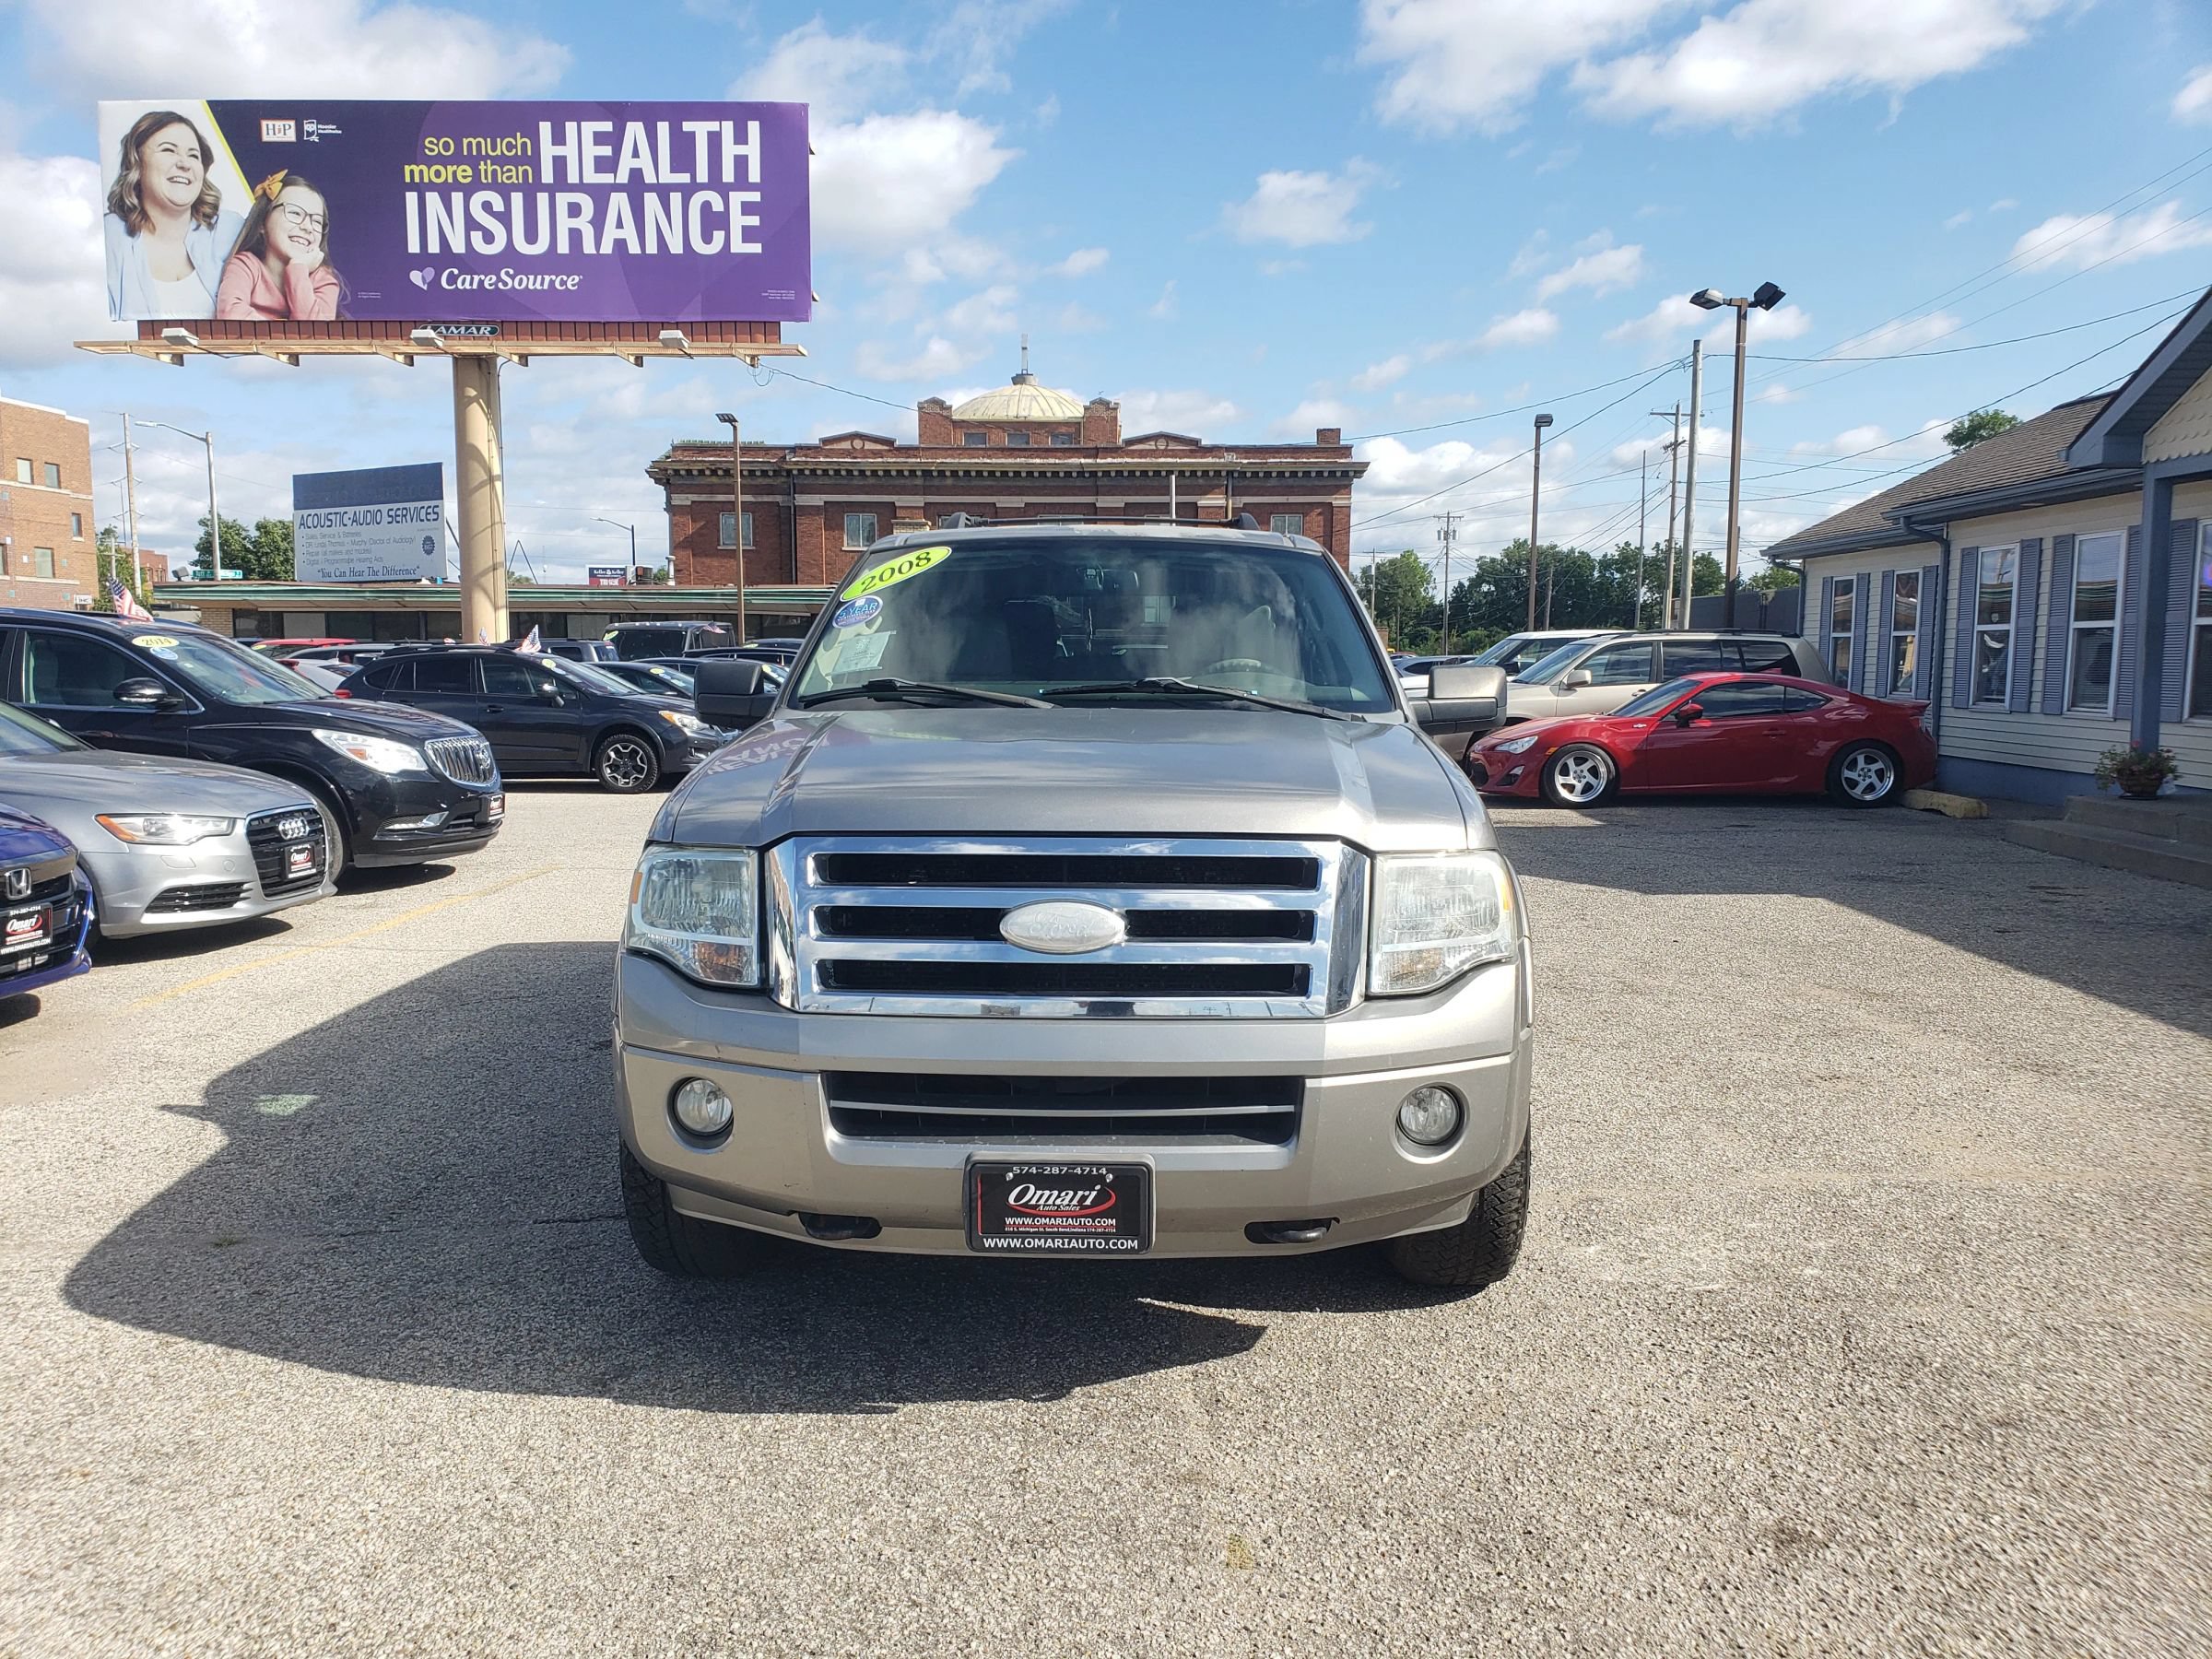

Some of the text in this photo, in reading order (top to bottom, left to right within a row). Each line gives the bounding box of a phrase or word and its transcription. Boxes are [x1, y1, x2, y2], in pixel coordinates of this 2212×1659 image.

[424, 132, 531, 156] so much
[539, 121, 760, 183] HEALTH
[404, 160, 532, 184] more than
[405, 191, 762, 255] INSURANCE
[387, 505, 440, 524] SERVICES
[334, 568, 347, 577] Can
[349, 567, 364, 577] Hear
[367, 566, 379, 577] The
[861, 552, 931, 593] 2008
[849, 602, 878, 615] YEAR
[6, 914, 38, 931] Omari
[1012, 1166, 1107, 1175] 574-287-4714
[1008, 1184, 1101, 1206] Omari
[1005, 1217, 1116, 1226] WWW.OMARIAUTO.COM
[983, 1238, 1138, 1250] WWW.OMARIAUTO.COM
